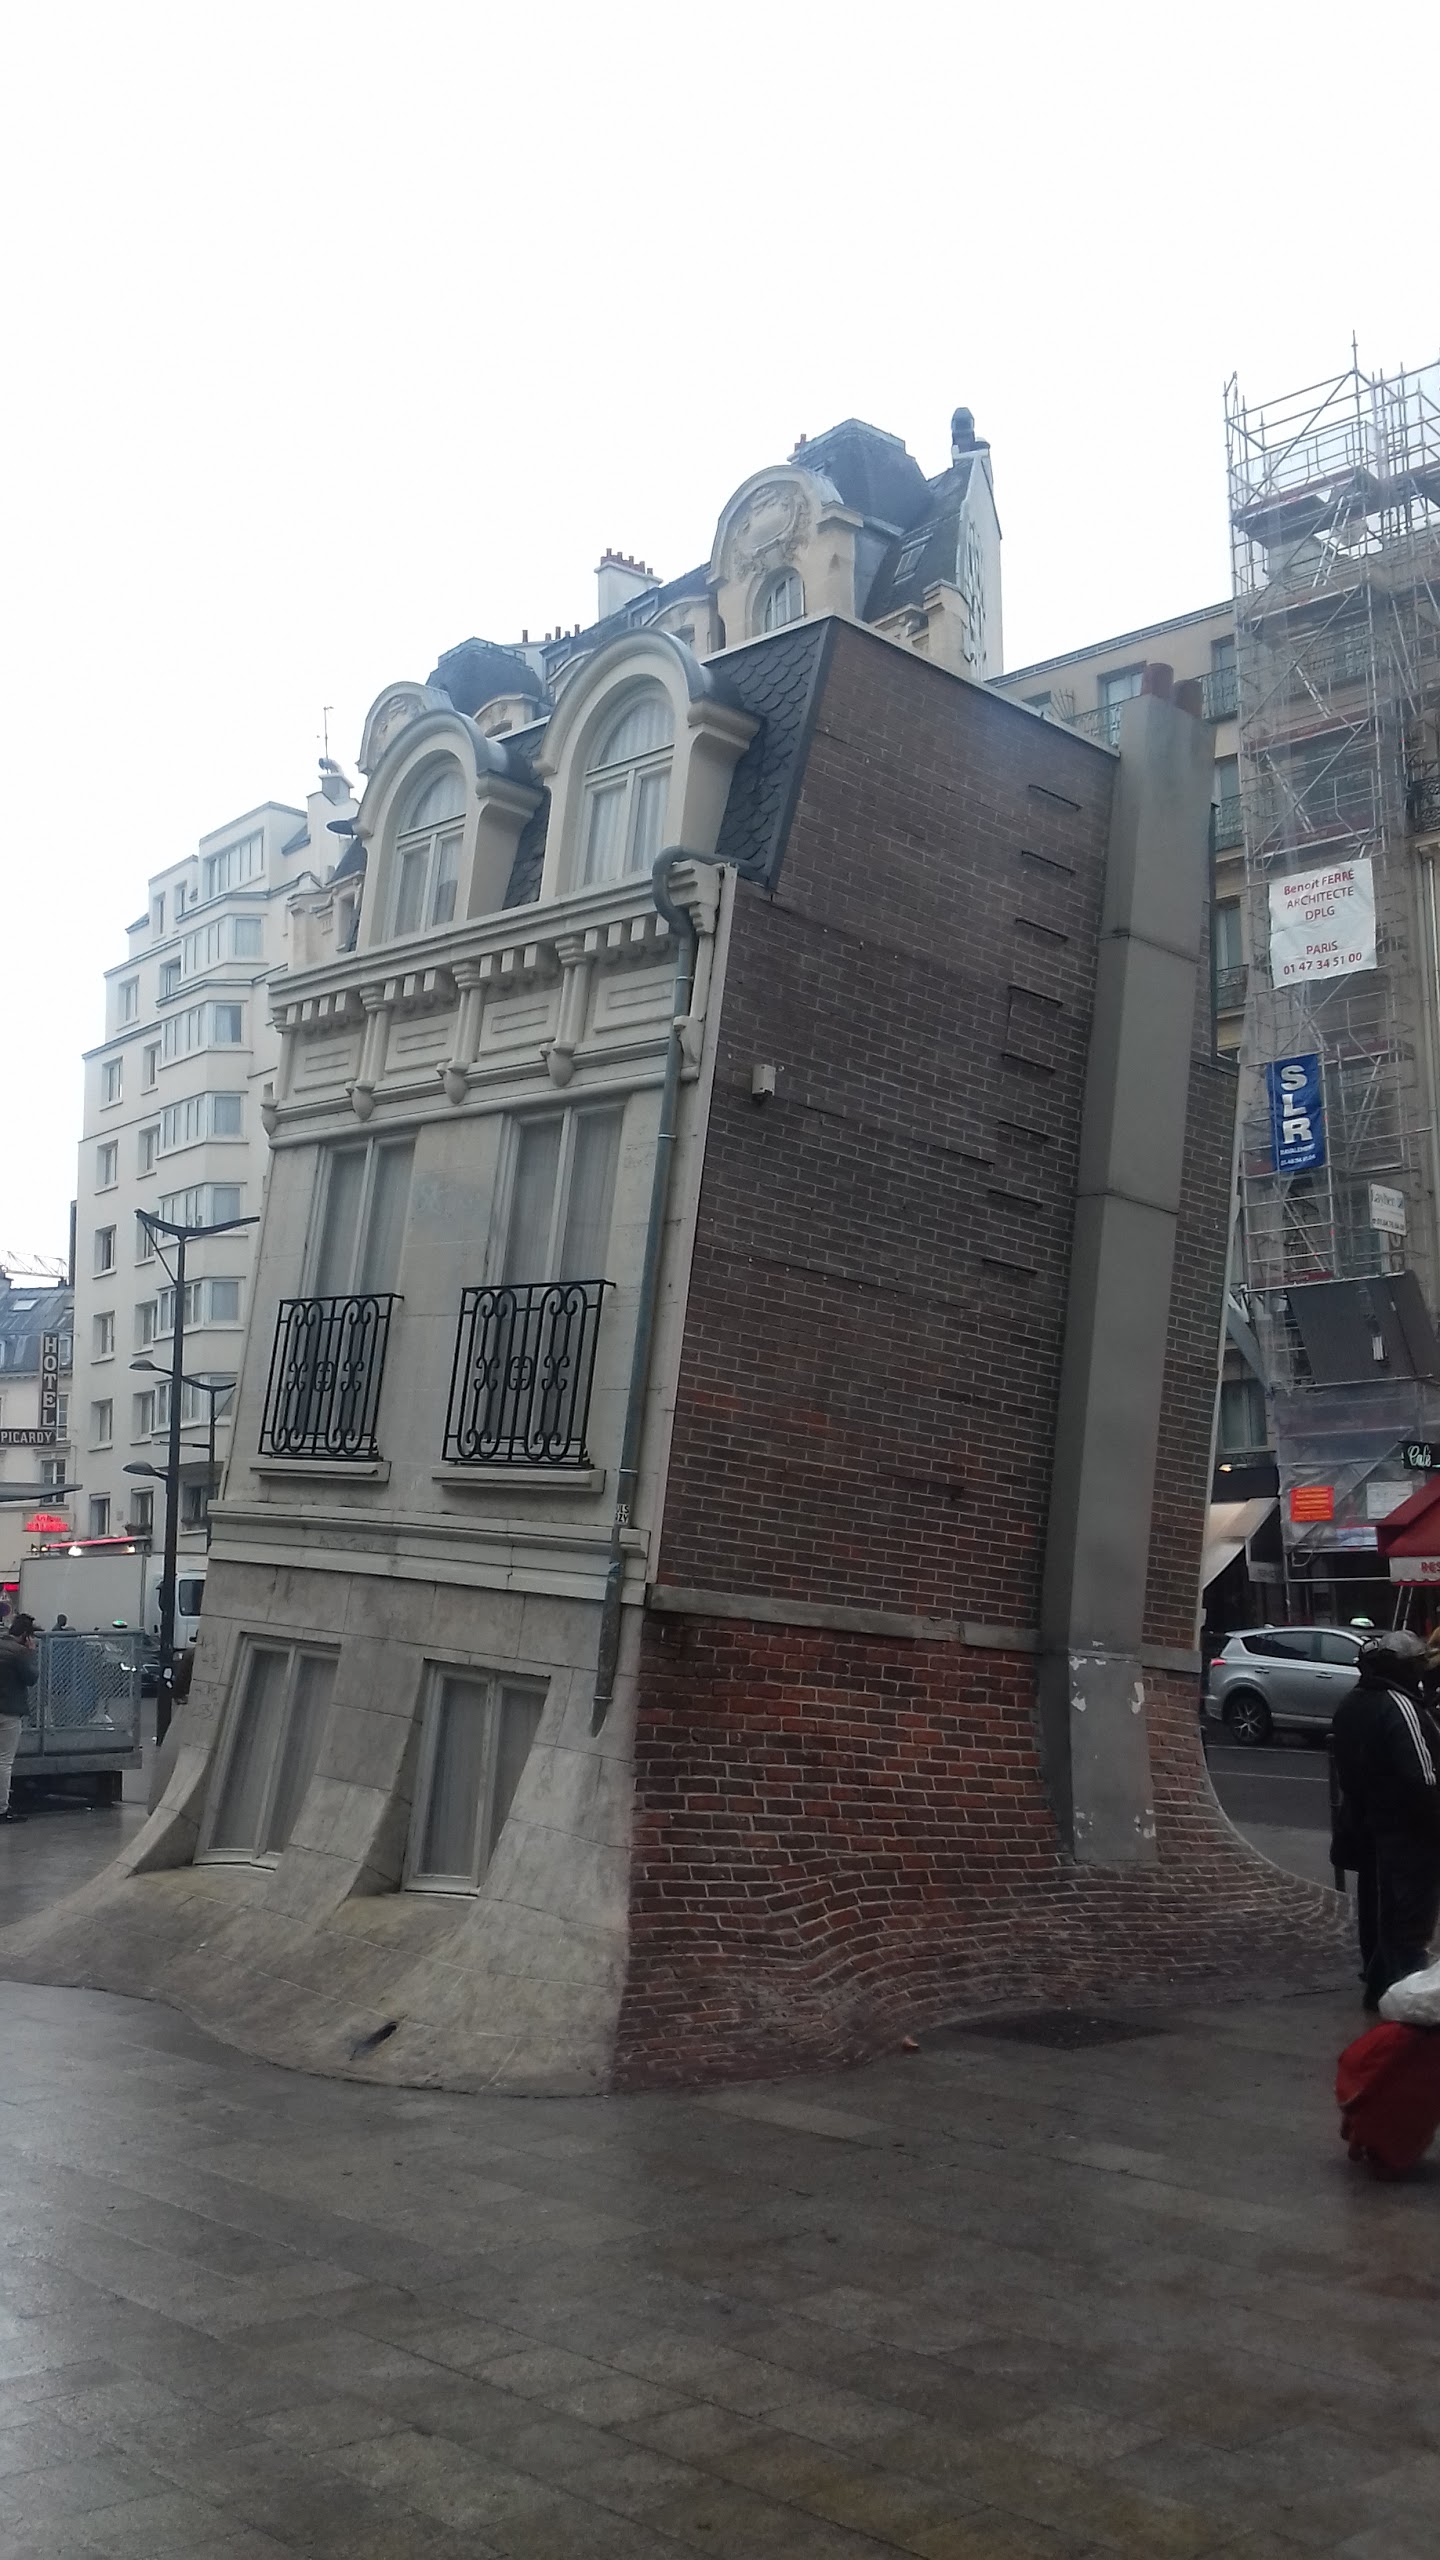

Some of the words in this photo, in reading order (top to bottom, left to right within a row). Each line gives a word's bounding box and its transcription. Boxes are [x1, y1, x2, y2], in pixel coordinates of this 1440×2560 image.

[1322, 868, 1355, 885] FERRÉ
[1287, 886, 1354, 909] ARCHITECTE
[1305, 905, 1335, 921] DPLG
[1306, 941, 1338, 955] PARIS
[1284, 964, 1295, 975] 01
[1299, 961, 1313, 971] 47
[1316, 958, 1330, 970] 34
[1333, 955, 1345, 967] 51
[1348, 952, 1362, 963] 00
[1281, 1065, 1313, 1144] SLR
[42, 1336, 58, 1426] HOTEL
[0, 1431, 53, 1444] PICARDY
